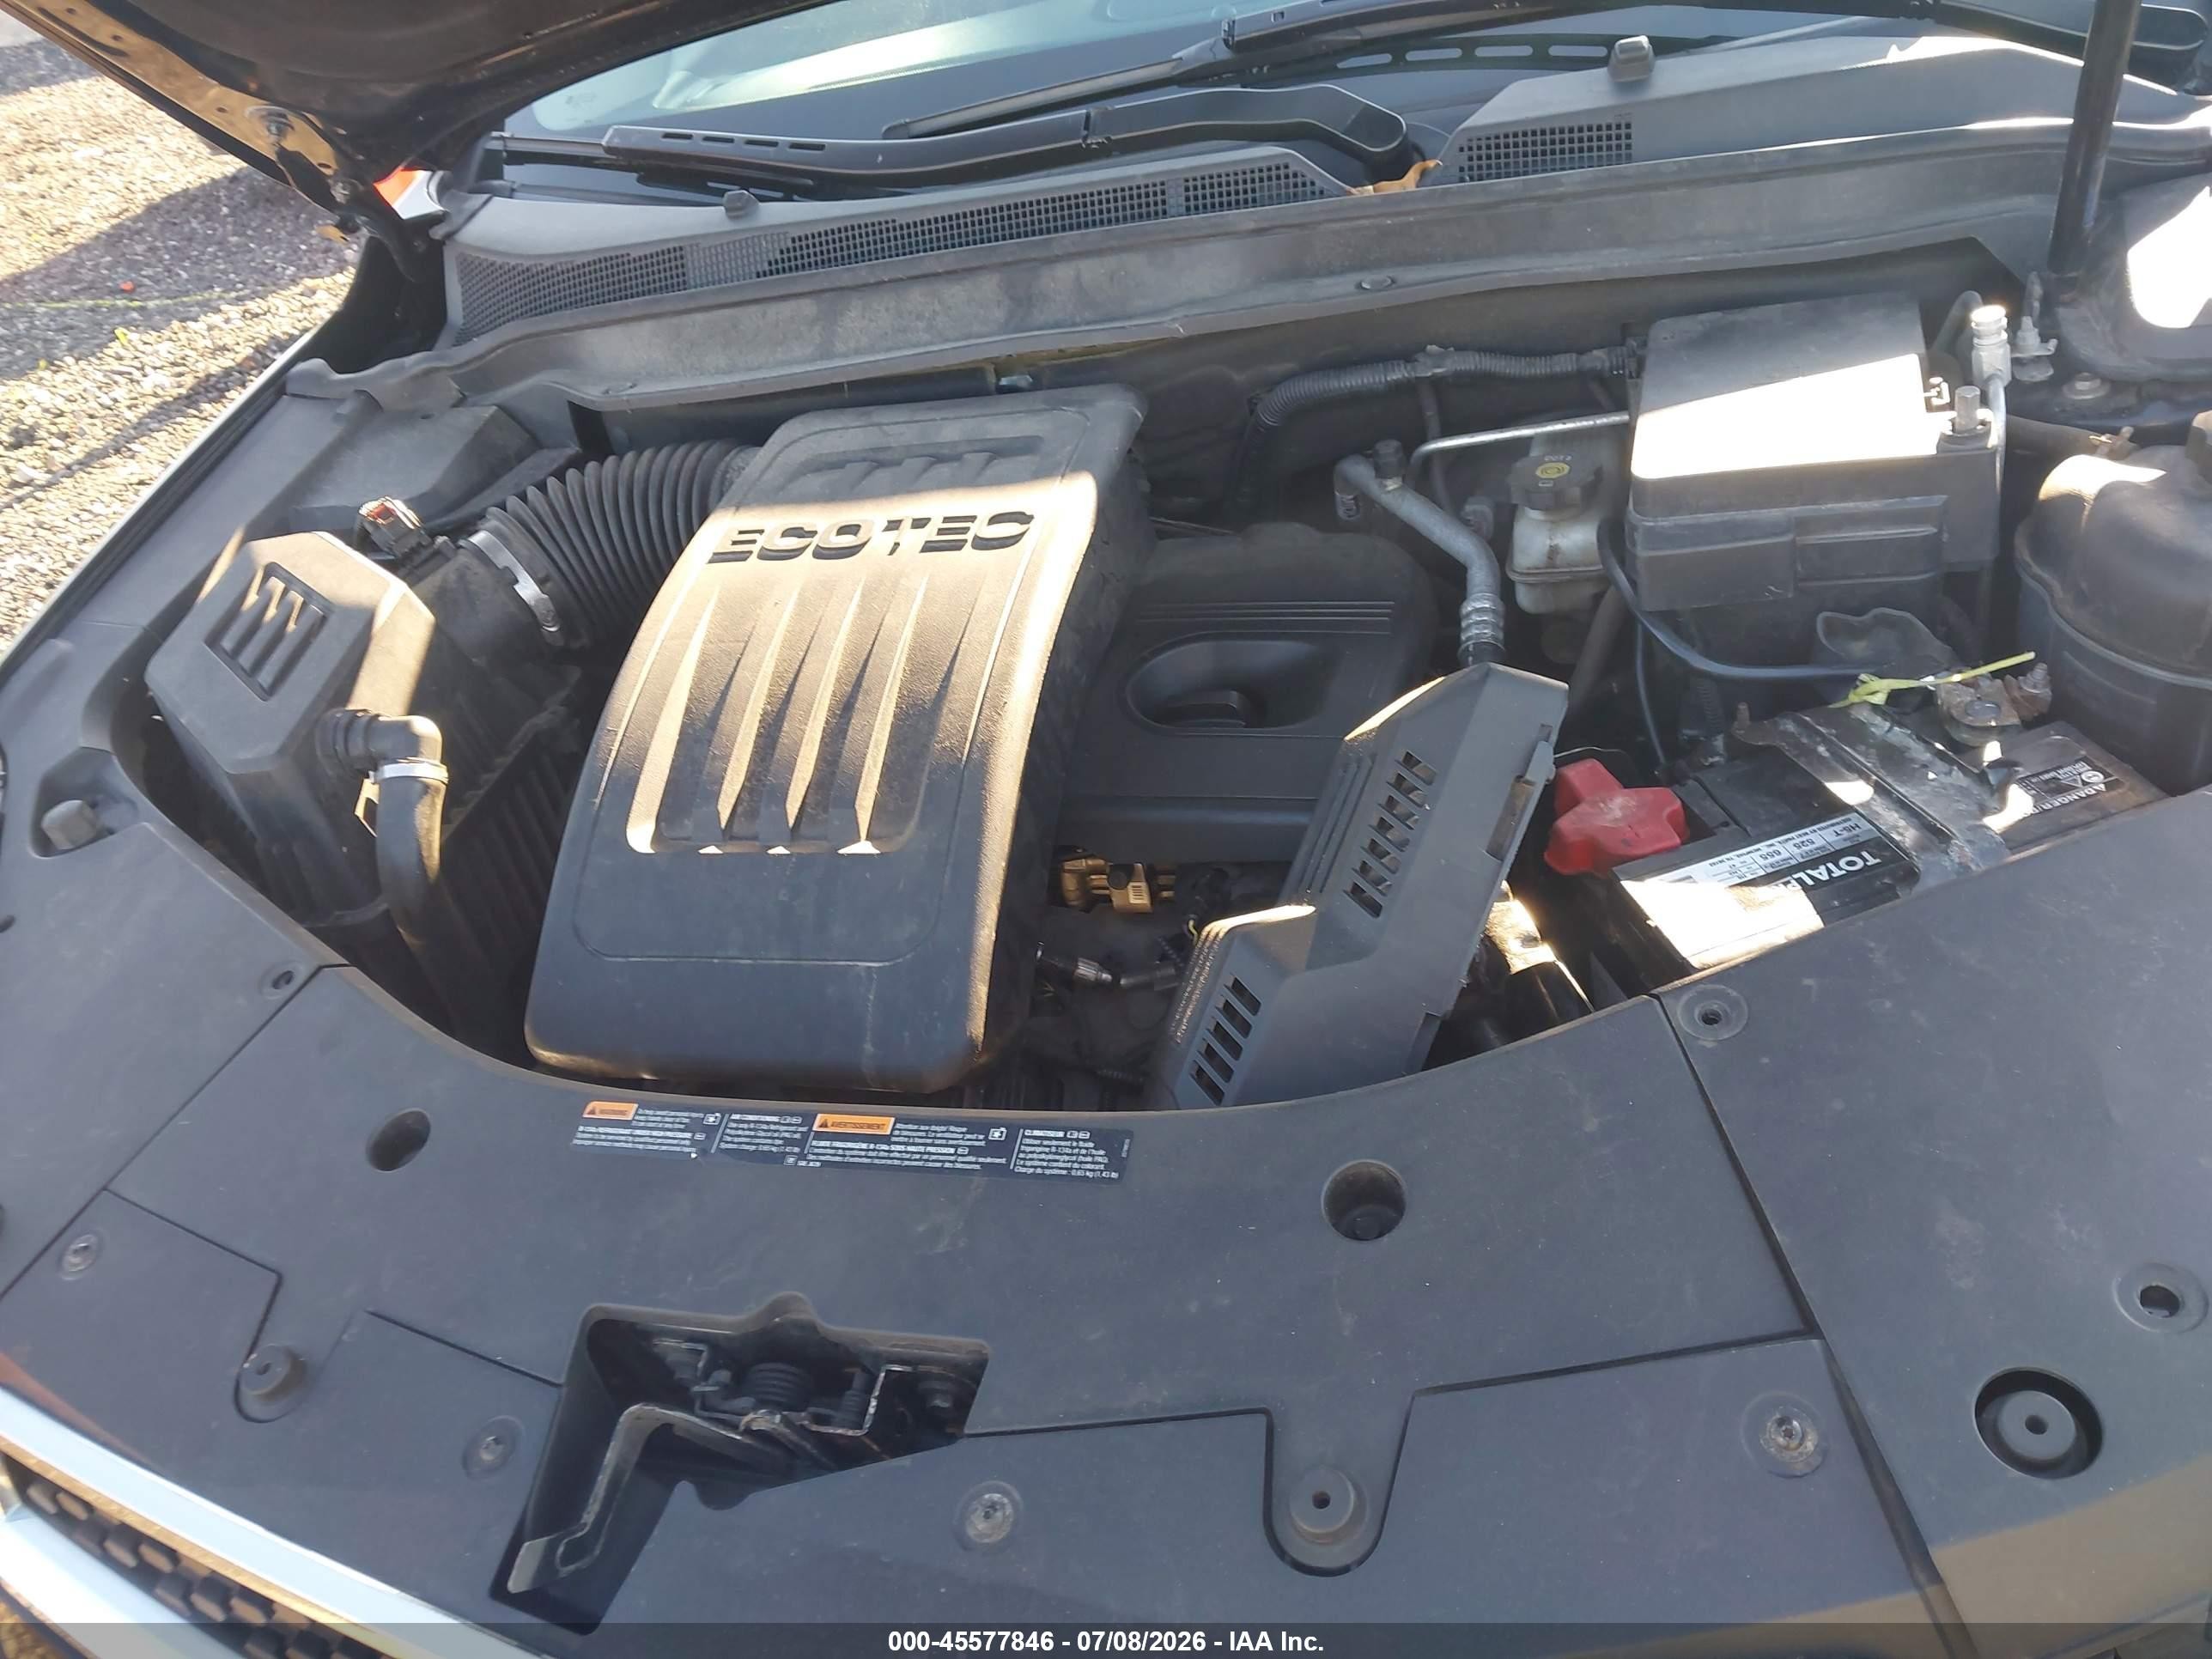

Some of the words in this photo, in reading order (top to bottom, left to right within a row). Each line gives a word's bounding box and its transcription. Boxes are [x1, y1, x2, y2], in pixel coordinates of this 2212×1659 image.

[705, 511, 1034, 564] ECOTEC
[1832, 823, 1862, 837] H5-T
[1793, 838, 1815, 850] 525
